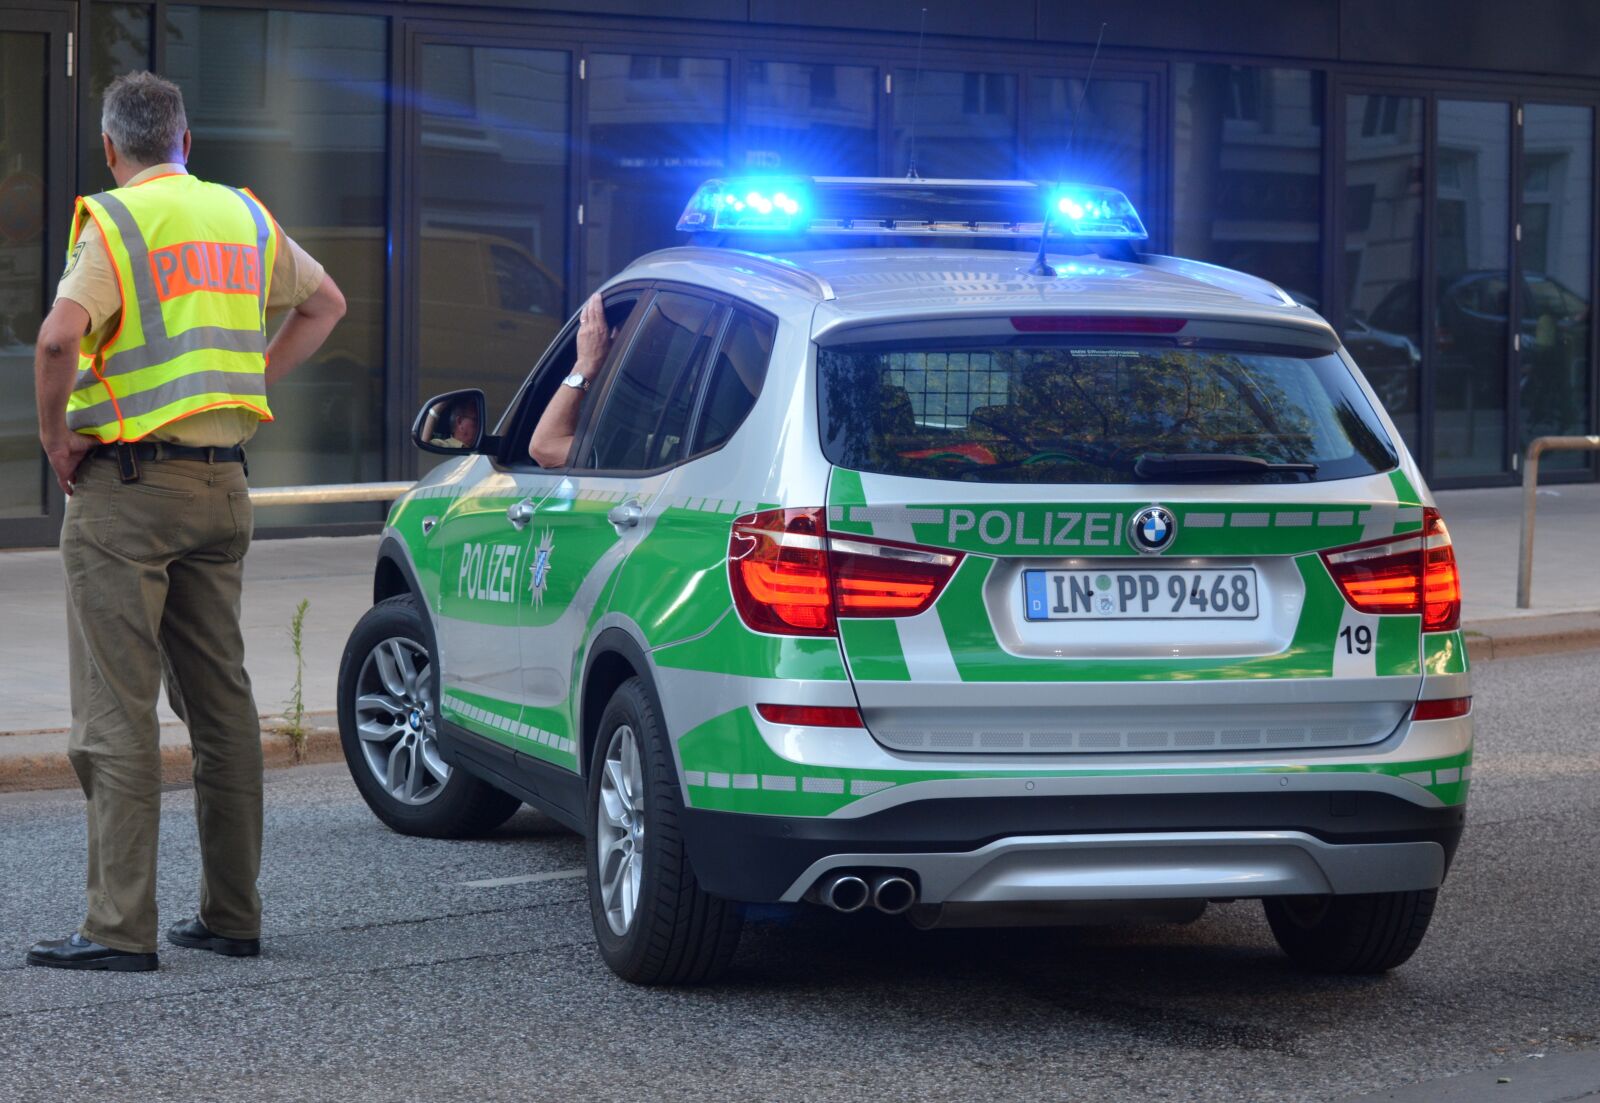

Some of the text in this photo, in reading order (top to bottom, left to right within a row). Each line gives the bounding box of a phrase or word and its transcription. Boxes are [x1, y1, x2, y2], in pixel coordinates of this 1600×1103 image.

[948, 509, 1123, 546] POLIZEI
[458, 542, 521, 603] POLIZEI
[1033, 599, 1041, 611] D
[1053, 575, 1250, 613] IN PP 9468
[1340, 625, 1372, 655] 19
